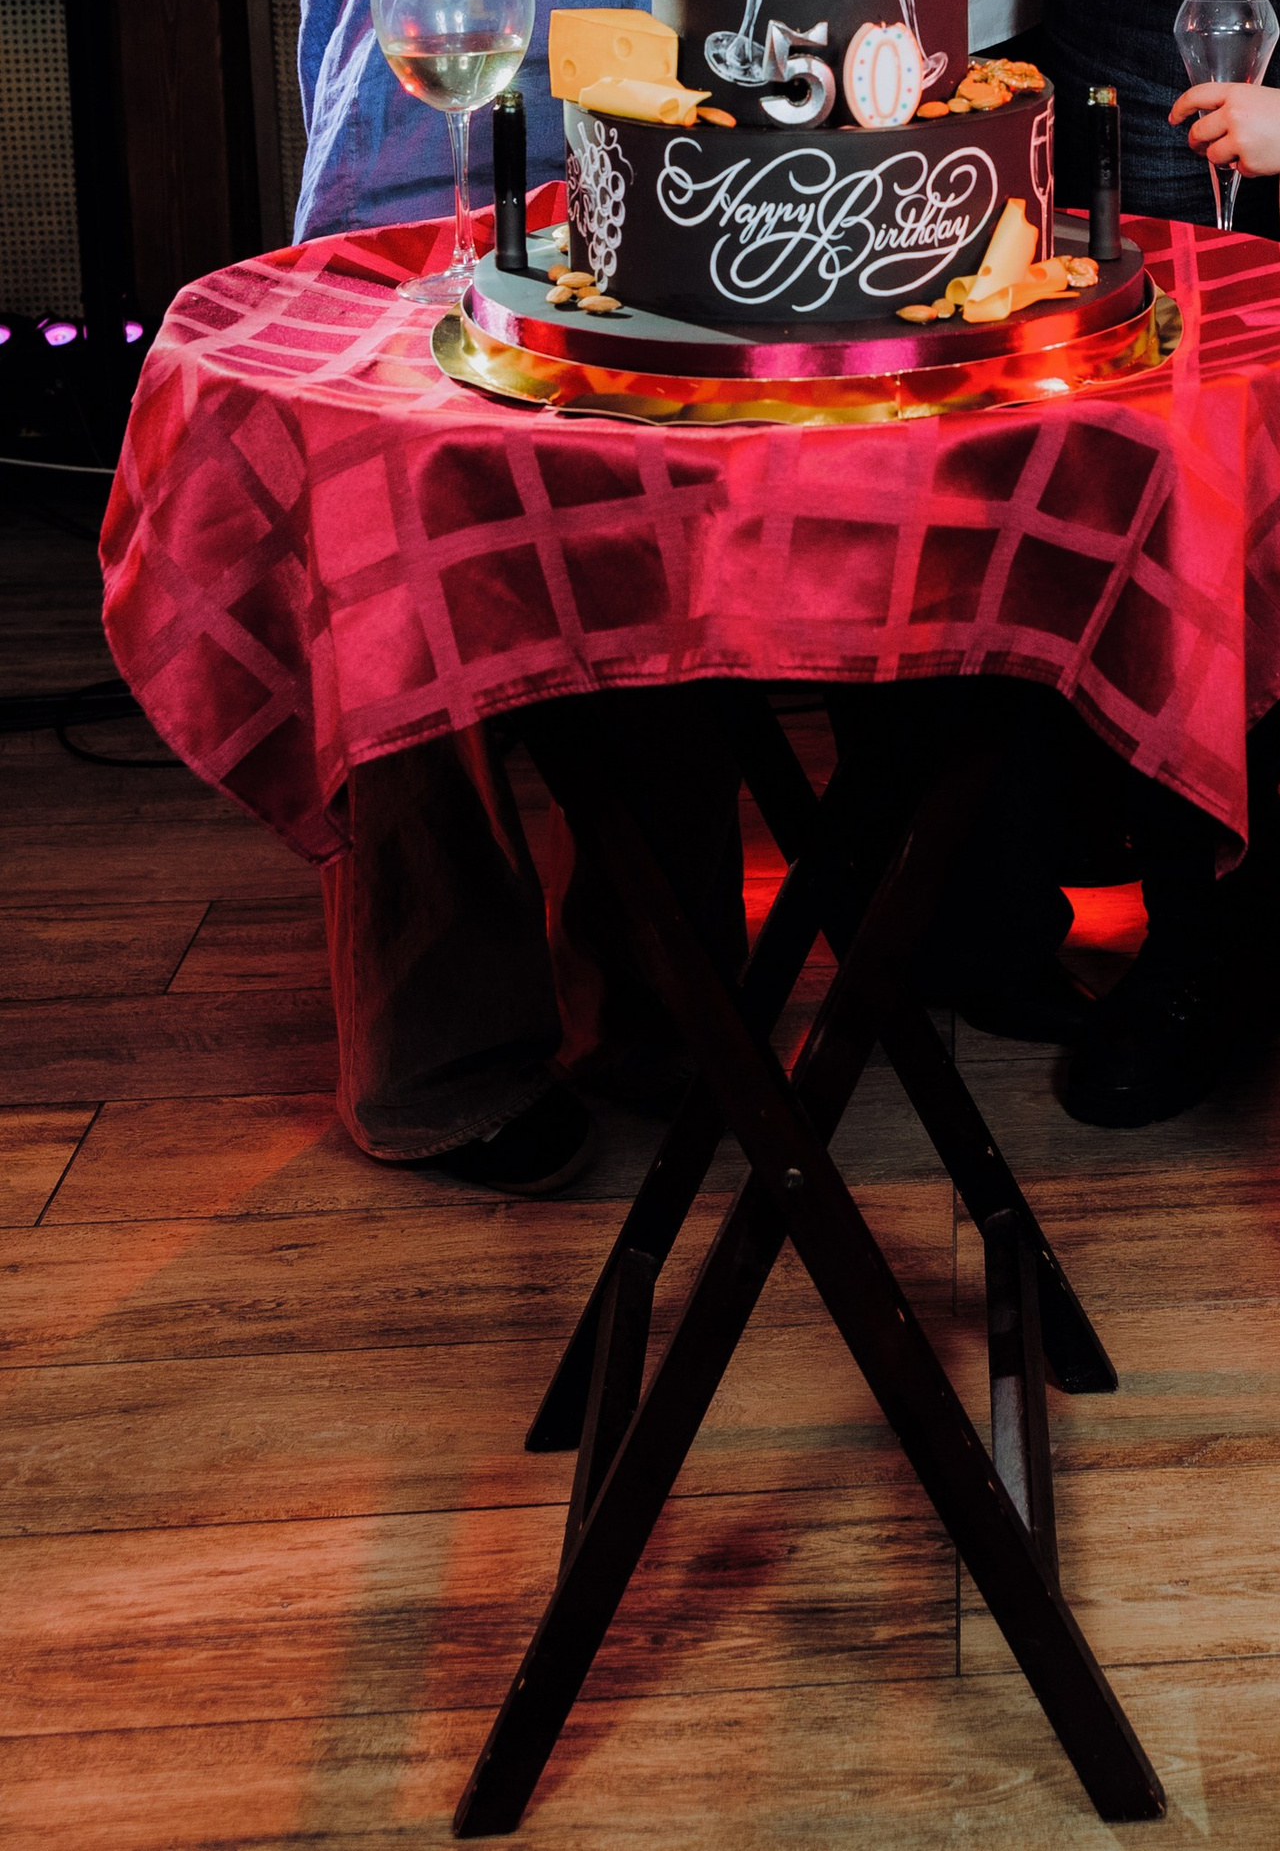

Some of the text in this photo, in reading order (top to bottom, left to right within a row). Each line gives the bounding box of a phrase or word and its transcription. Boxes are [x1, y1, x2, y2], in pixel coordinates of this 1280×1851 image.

[759, 20, 925, 129] 50
[656, 137, 999, 298] Happy Birthday
